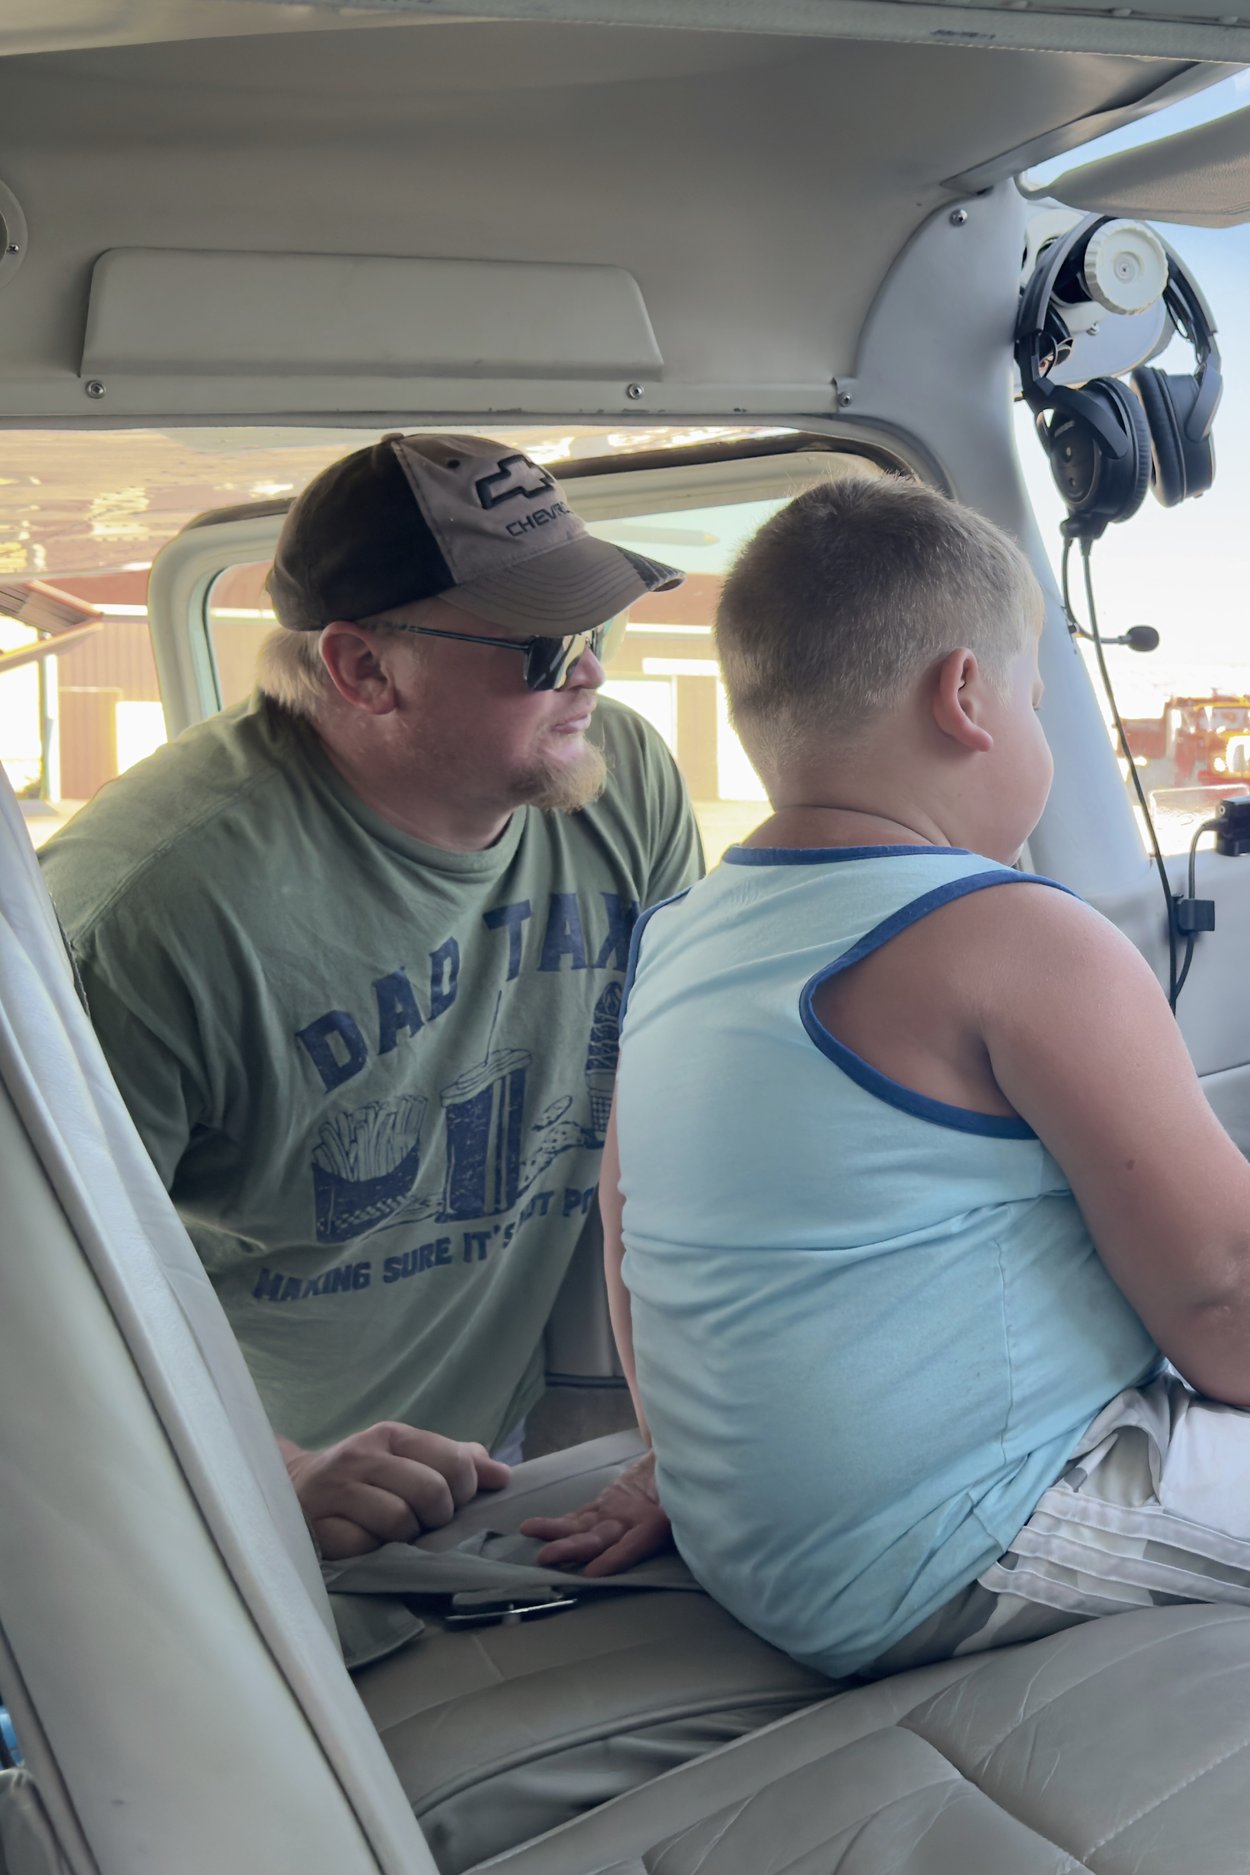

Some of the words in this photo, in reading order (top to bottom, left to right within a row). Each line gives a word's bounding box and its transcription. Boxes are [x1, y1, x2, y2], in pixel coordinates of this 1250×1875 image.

[295, 936, 460, 1093] DAD
[483, 892, 638, 982] TAX
[252, 1262, 371, 1302] MAKING
[383, 1237, 452, 1284] SURE
[463, 1222, 516, 1263] IT'S
[519, 1189, 554, 1225] OT
